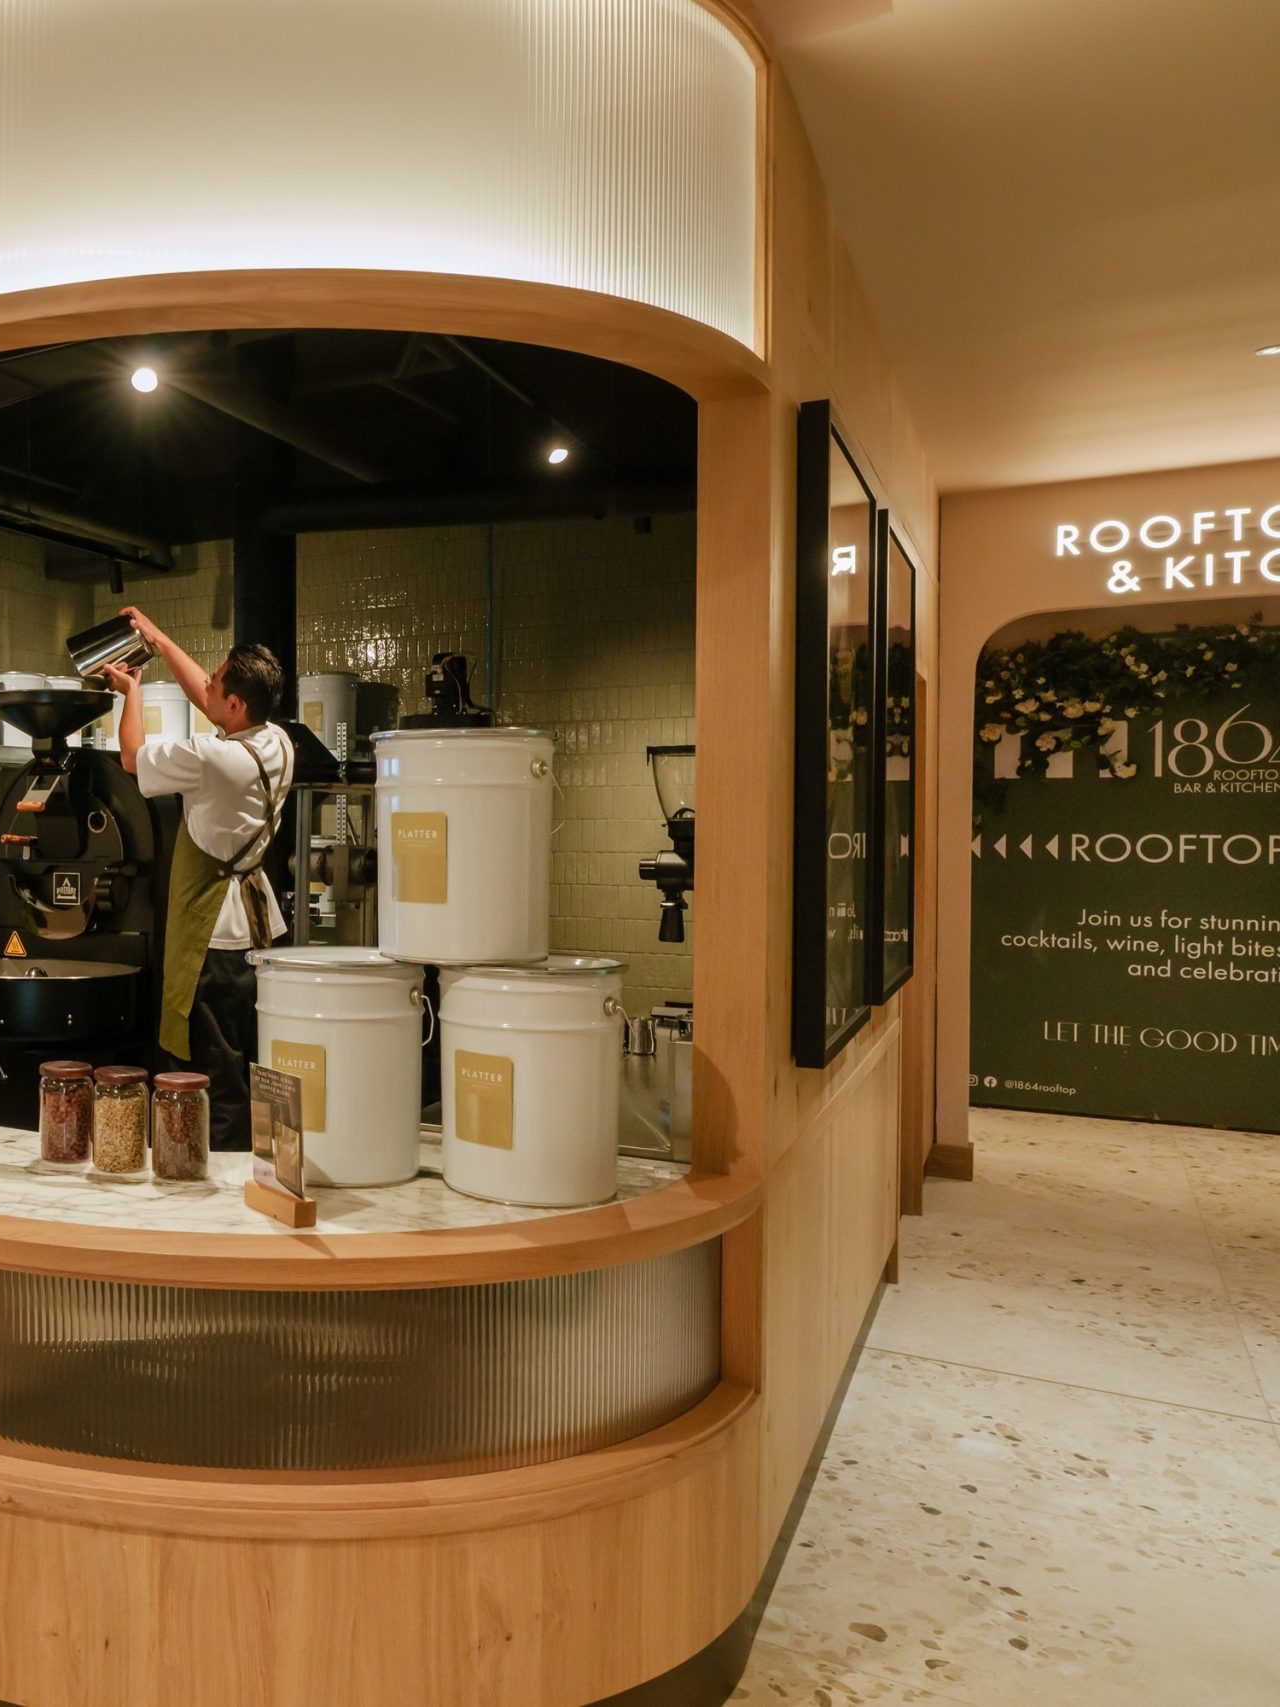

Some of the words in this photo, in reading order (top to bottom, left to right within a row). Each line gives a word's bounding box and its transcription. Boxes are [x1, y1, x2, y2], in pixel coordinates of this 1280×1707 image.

[1107, 560, 1142, 594] &
[1174, 782, 1201, 793] BAR
[1205, 782, 1216, 793] &
[1220, 782, 1280, 793] KITCHEN
[398, 829, 437, 839] PLATTER
[1071, 833, 1280, 865] ROOFTOP
[1077, 908, 1121, 927] Join
[1130, 914, 1153, 928] us
[1160, 909, 1192, 929] for
[1199, 913, 1280, 932] stunnin
[1001, 929, 1098, 953] cocktails,
[1106, 936, 1166, 956] wine,
[1174, 935, 1224, 960] light
[1128, 959, 1171, 978] and
[1043, 1020, 1082, 1042] LET
[1090, 1023, 1132, 1046] THE
[1139, 1027, 1238, 1053] GOOD
[278, 1056, 317, 1070] PLATTER
[462, 1068, 504, 1083] PLATTER
[1004, 1080, 1077, 1096] @1864rooftop
